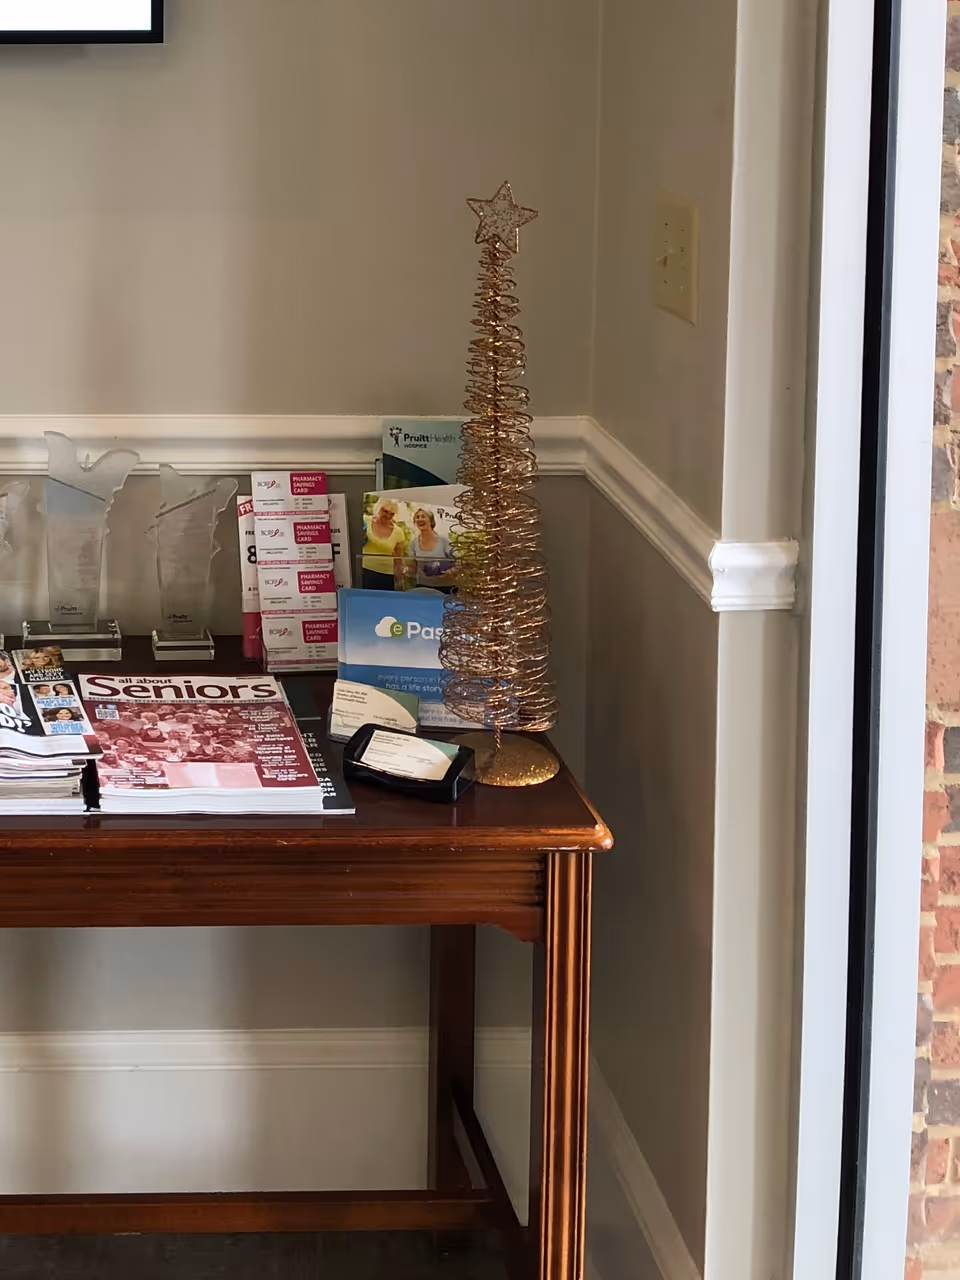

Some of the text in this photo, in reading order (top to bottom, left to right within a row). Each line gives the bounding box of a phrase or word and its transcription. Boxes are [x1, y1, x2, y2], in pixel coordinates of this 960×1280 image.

[135, 677, 173, 685] about
[86, 675, 277, 699] Seniors
[408, 683, 421, 691] life
[422, 685, 442, 694] story
